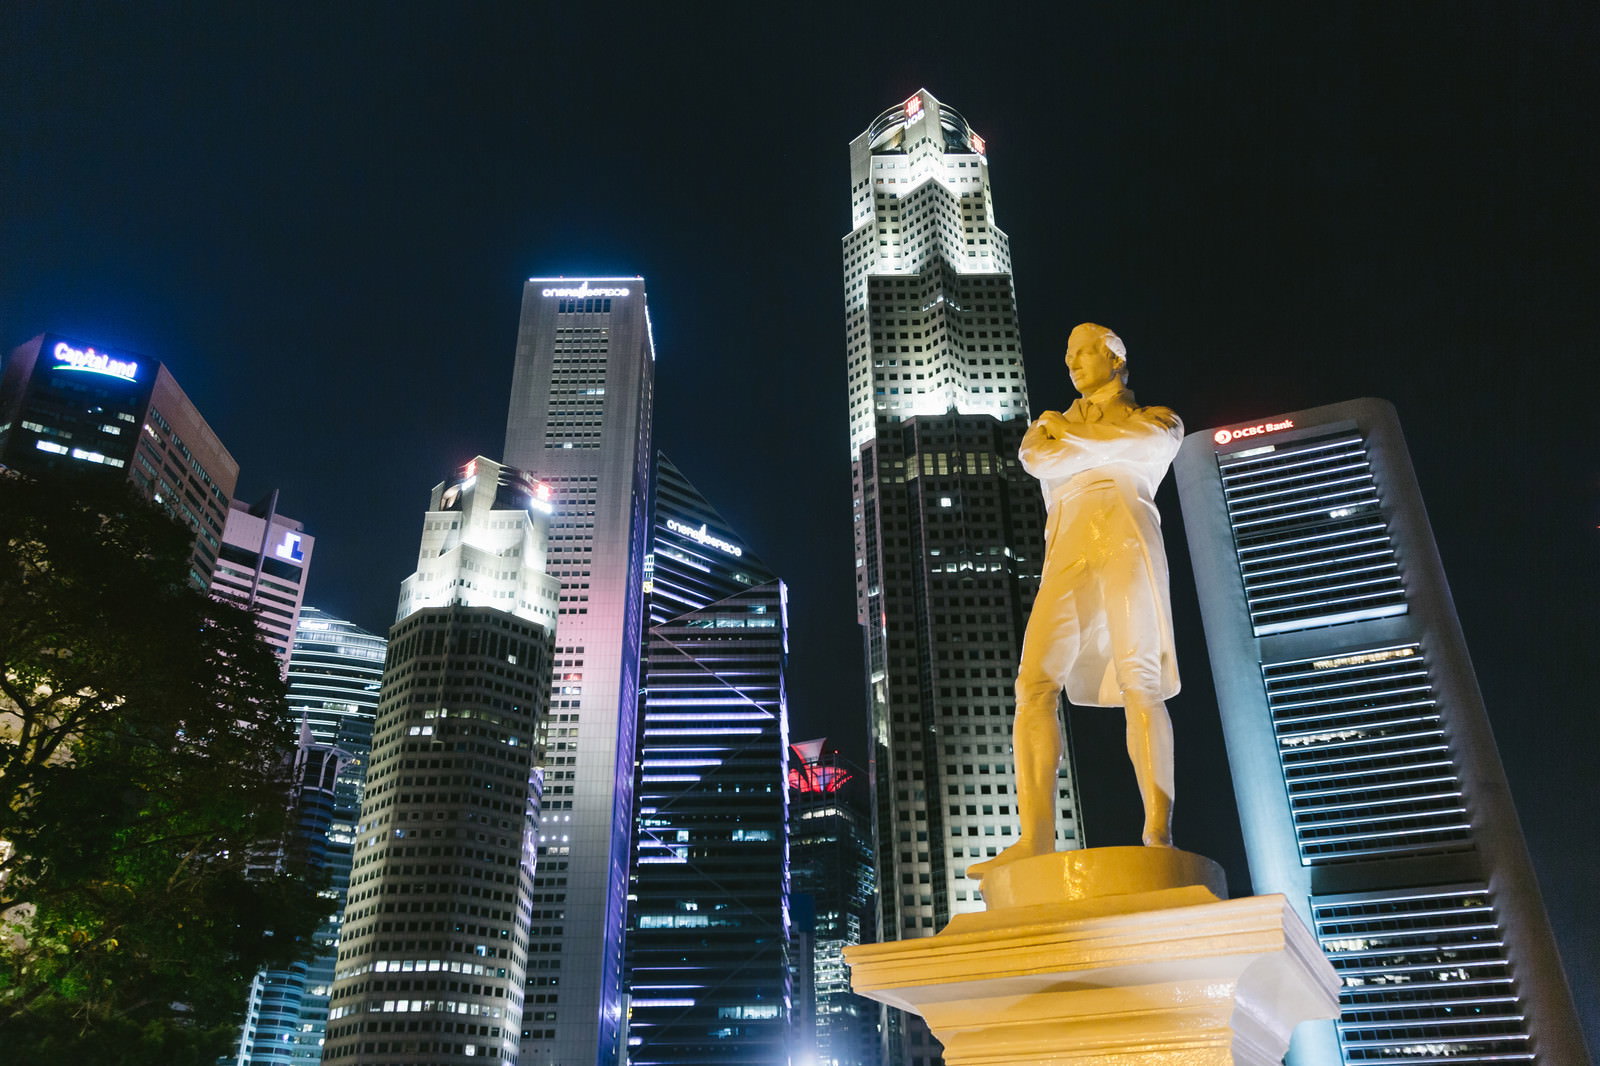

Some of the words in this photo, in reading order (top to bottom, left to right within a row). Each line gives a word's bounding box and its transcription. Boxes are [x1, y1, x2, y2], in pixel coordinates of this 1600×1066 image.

[904, 109, 925, 129] UOB
[54, 343, 138, 378] CapitaLand
[1232, 425, 1265, 439] OCBC
[1265, 419, 1294, 432] Bank
